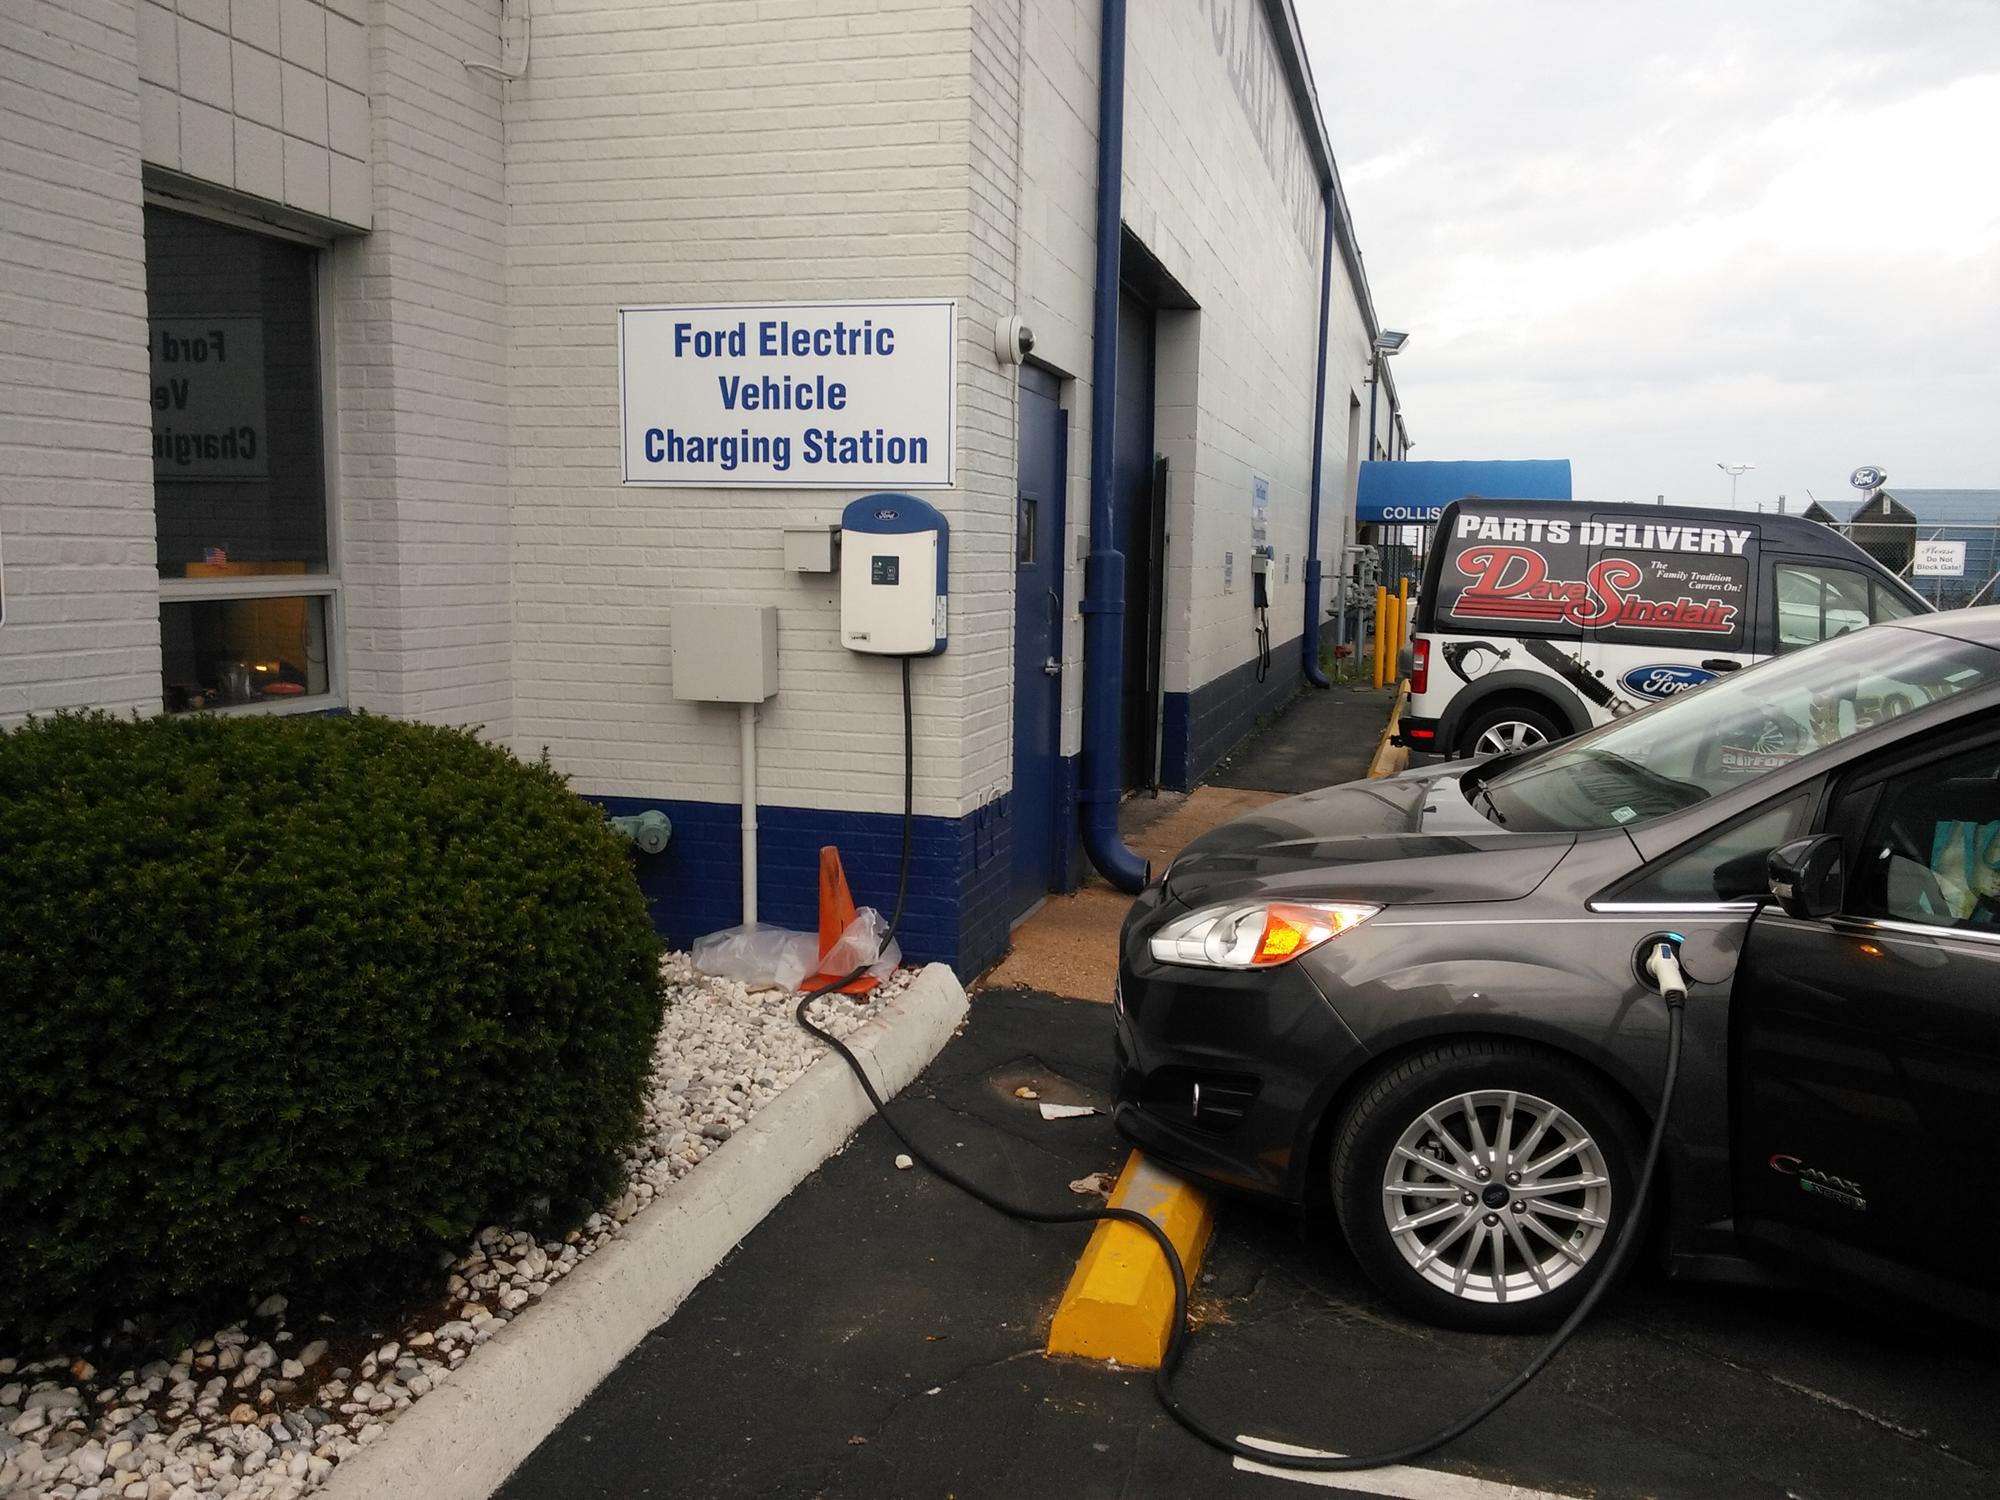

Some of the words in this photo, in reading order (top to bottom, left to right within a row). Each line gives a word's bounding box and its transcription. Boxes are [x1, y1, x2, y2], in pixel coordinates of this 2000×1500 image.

[674, 322, 746, 358] Ford
[759, 319, 895, 357] Electric
[718, 375, 847, 411] Vehicle
[644, 427, 791, 471] Charging
[802, 427, 928, 465] Station
[1382, 506, 1442, 520] COLLIS
[1456, 514, 1571, 545] PARTS
[1579, 521, 1753, 555] DELIVERY
[1650, 560, 1669, 570] The
[1656, 570, 1689, 582] Family
[1690, 571, 1732, 583] Tradition
[1916, 563, 1938, 571] Block
[1456, 545, 1591, 602] Dave
[1563, 558, 1739, 630] Sinclair
[1688, 581, 1722, 591] Carries
[1723, 583, 1743, 593] On!
